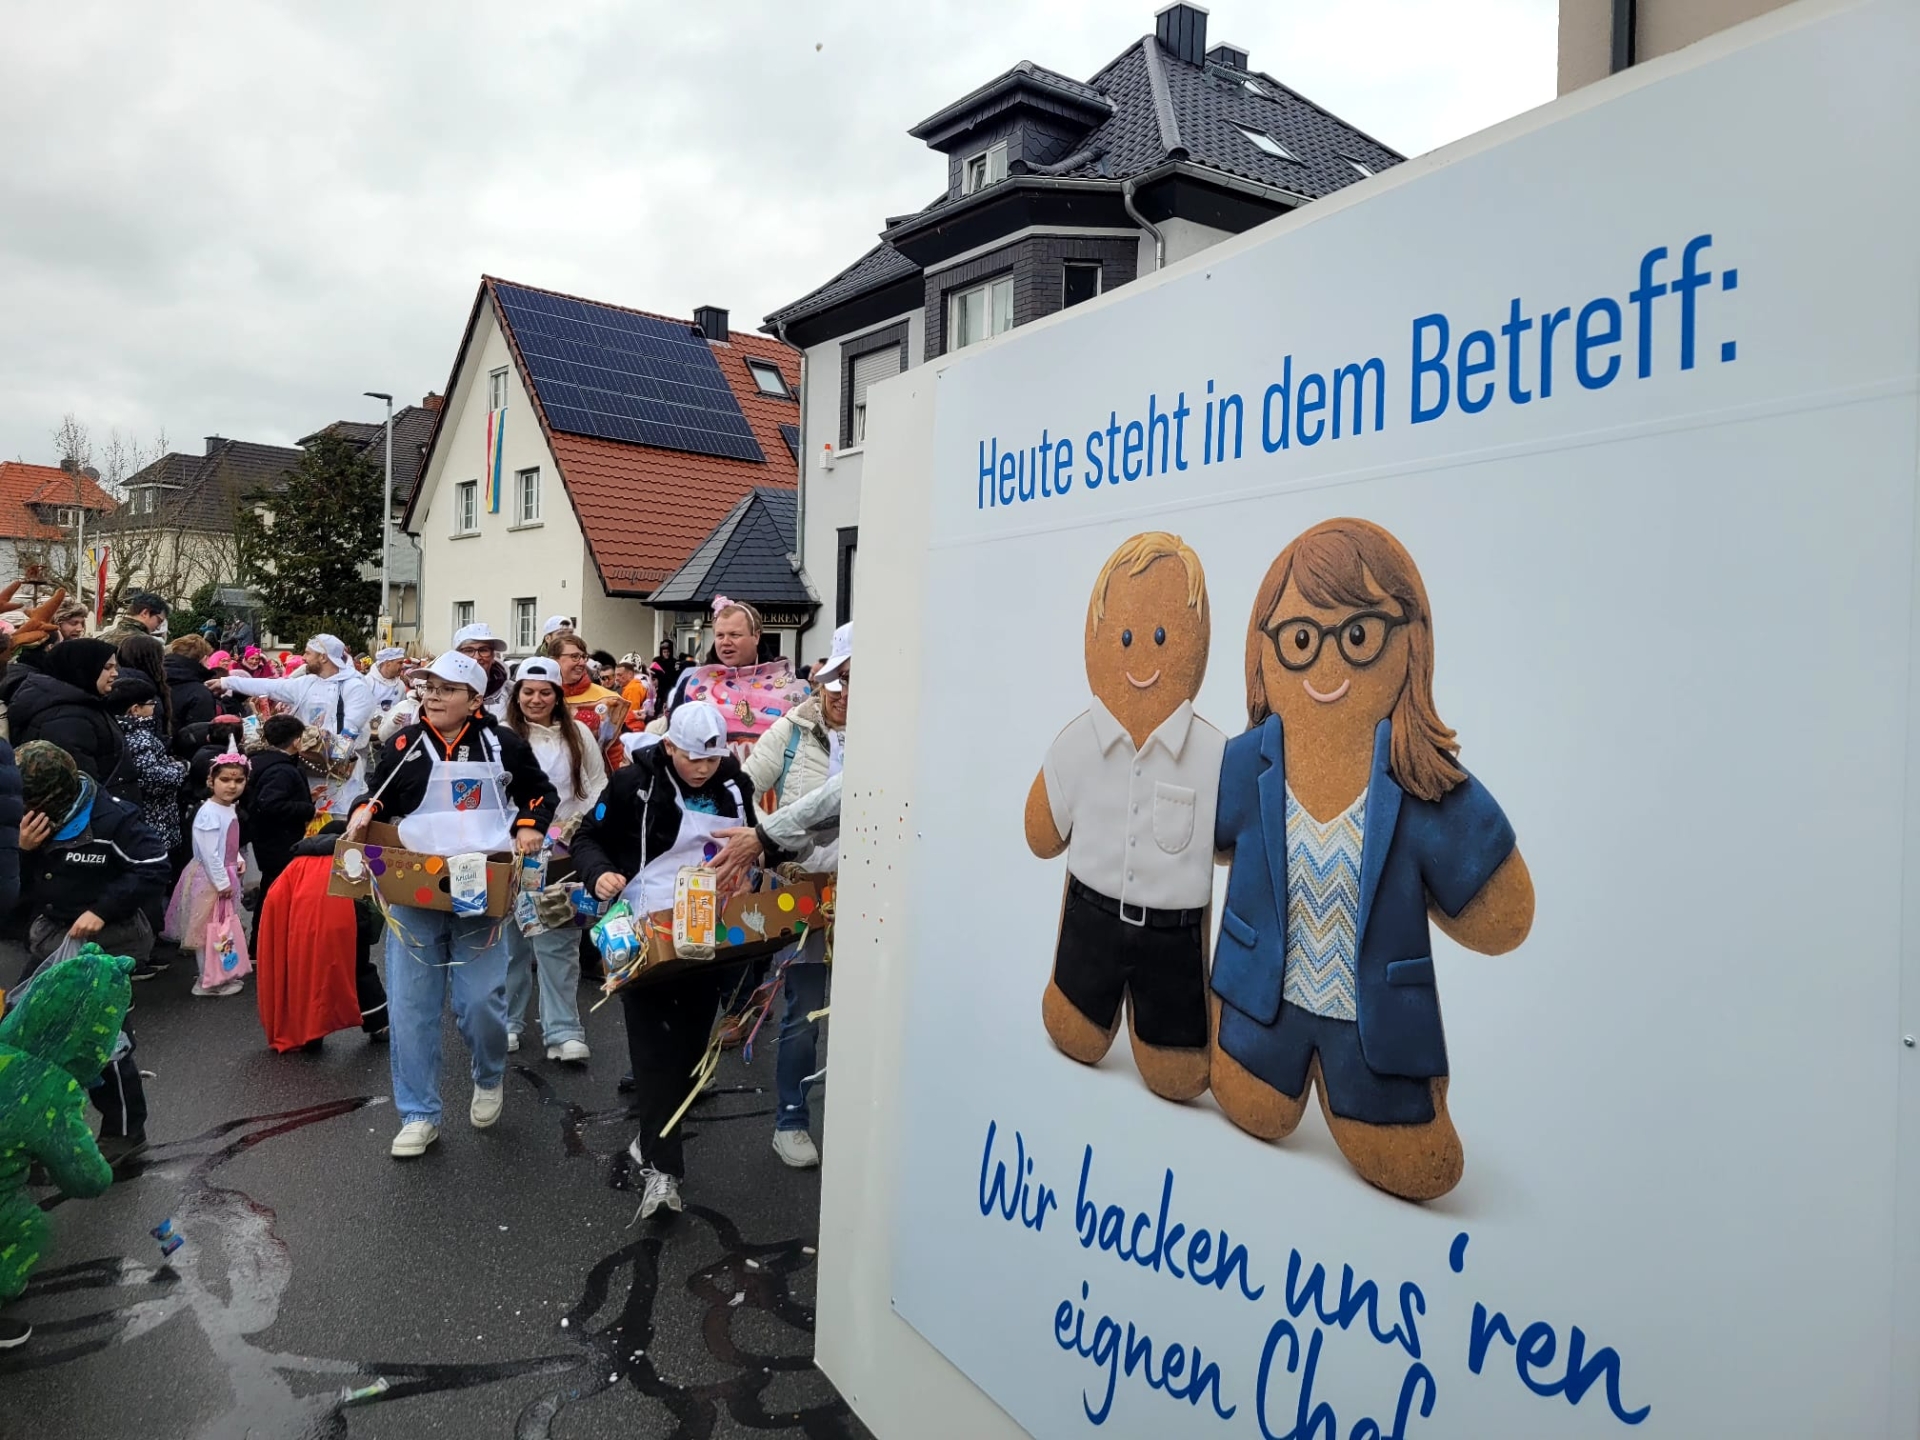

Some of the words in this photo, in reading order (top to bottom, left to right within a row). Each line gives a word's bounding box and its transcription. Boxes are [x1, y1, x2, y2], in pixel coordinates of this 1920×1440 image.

[978, 430, 1074, 509] Heute
[1084, 391, 1191, 490] steht
[1203, 379, 1244, 466] in
[1261, 354, 1386, 455] dem
[1410, 233, 1739, 425] Betreff:
[65, 851, 106, 864] POLIZEI
[979, 1121, 1058, 1233] Wir
[1075, 1143, 1265, 1302] backen
[1054, 1280, 1237, 1427] eignen
